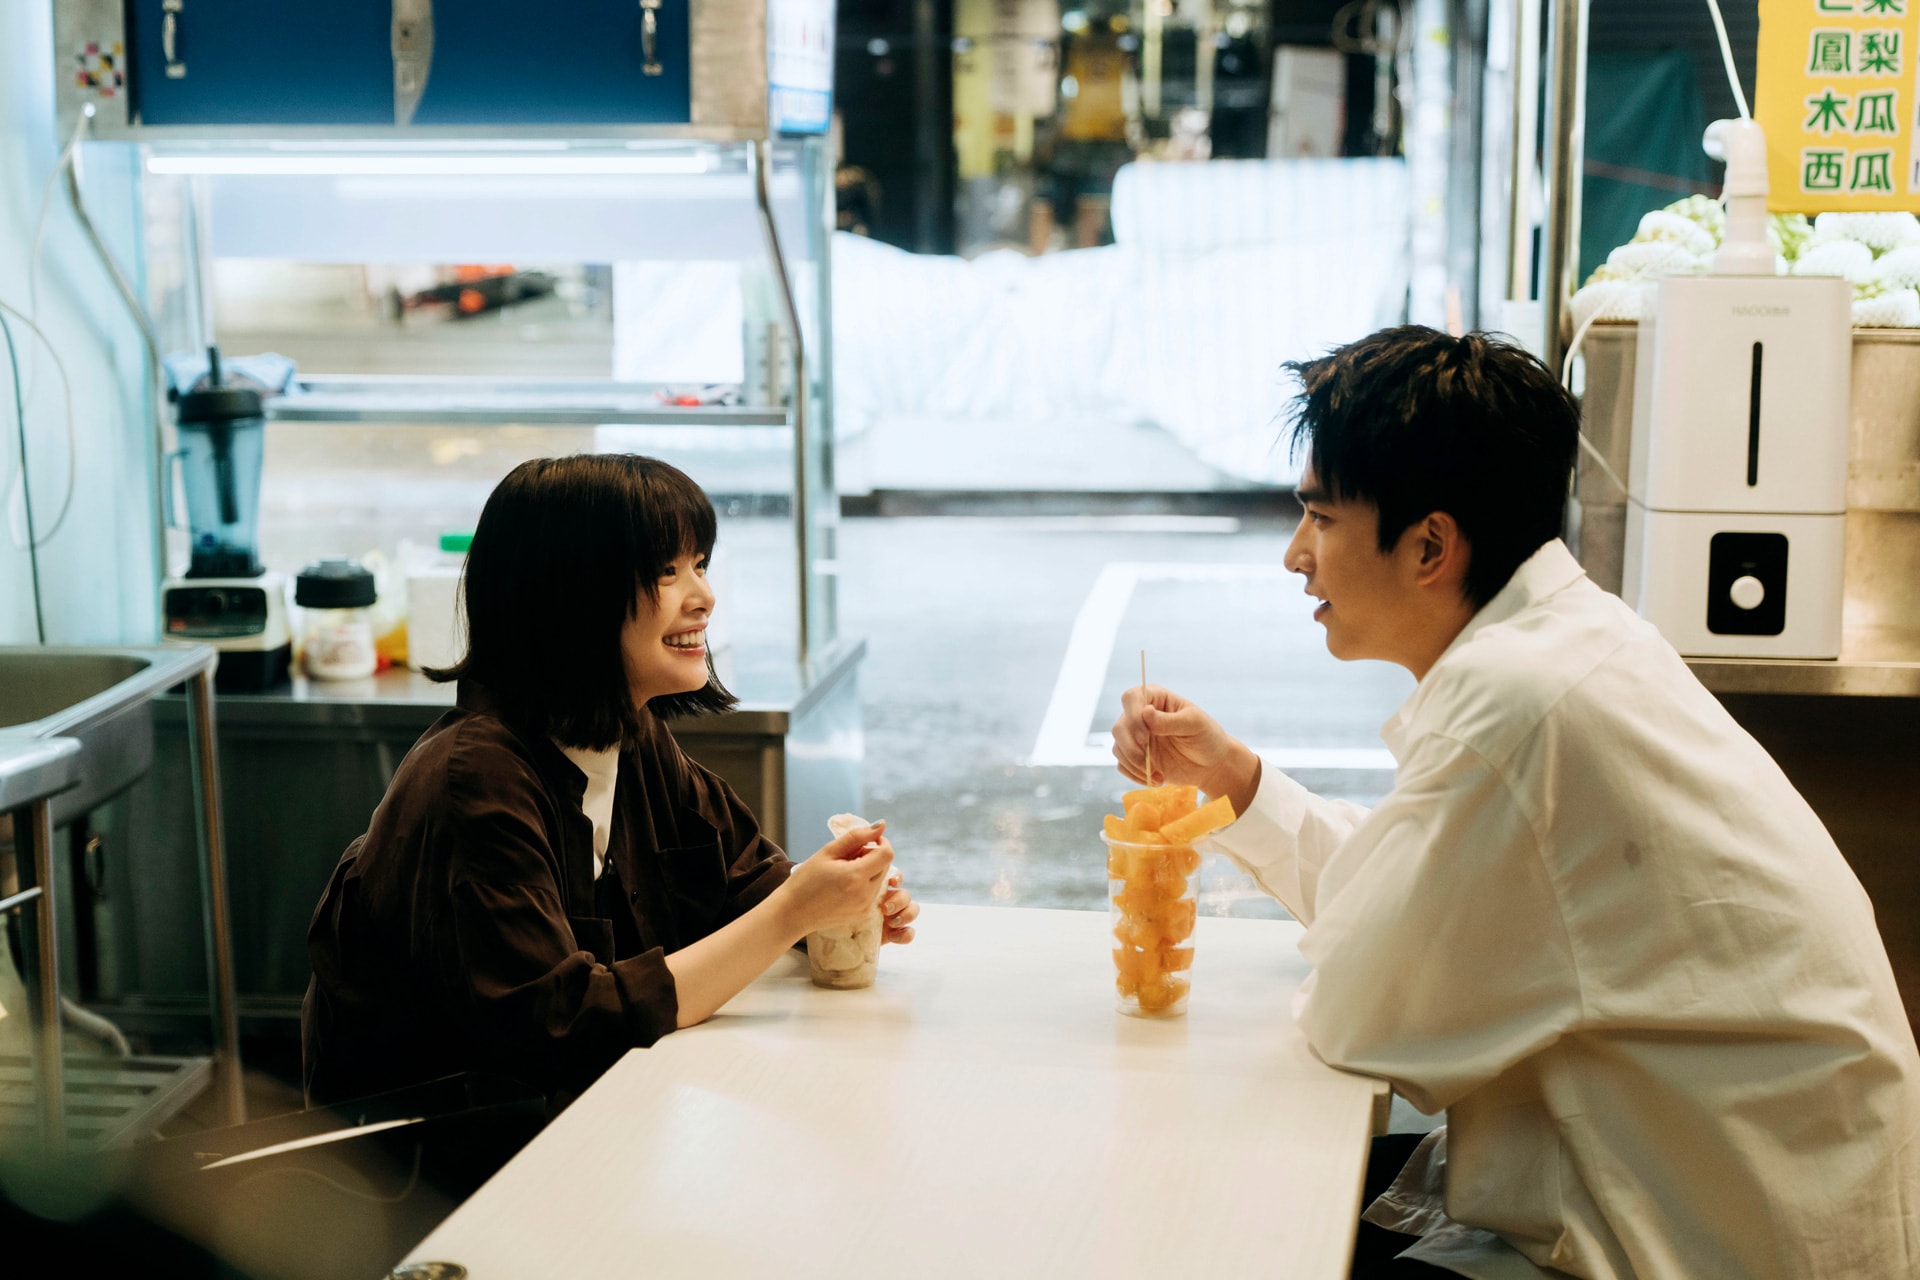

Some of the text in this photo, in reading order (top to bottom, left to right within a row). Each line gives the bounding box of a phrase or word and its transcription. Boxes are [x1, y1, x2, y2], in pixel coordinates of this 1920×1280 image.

[1810, 32, 1899, 72] 鳳梨
[1807, 92, 1895, 131] 木瓜
[1805, 151, 1890, 190] 西瓜
